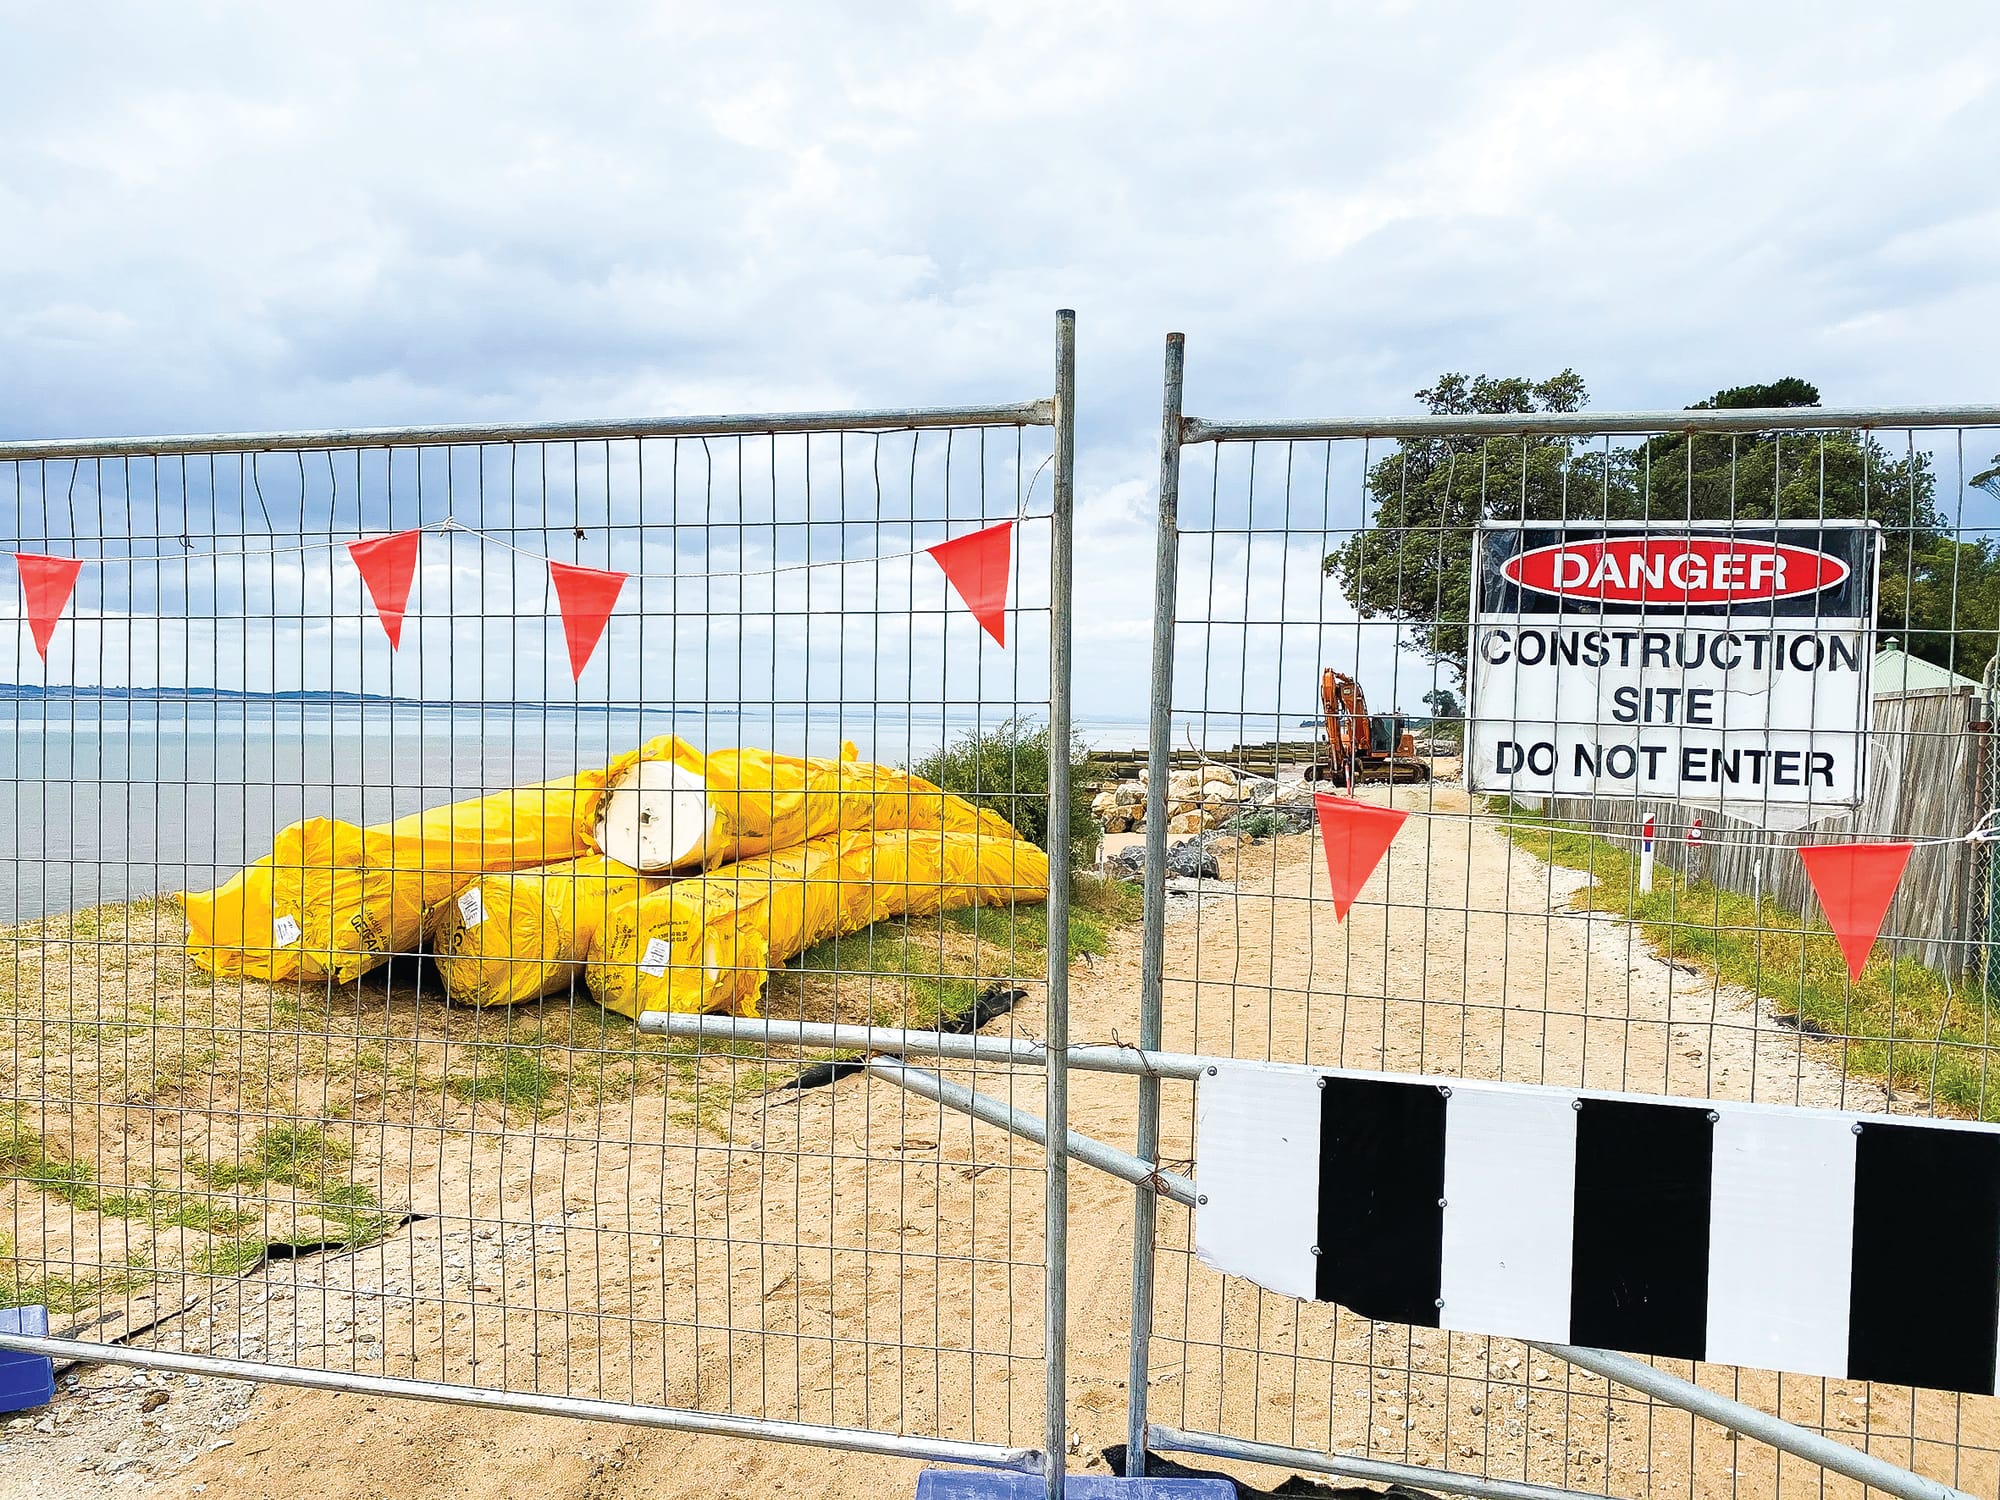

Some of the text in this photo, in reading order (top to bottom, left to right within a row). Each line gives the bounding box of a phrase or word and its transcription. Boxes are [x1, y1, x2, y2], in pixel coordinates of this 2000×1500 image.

[1553, 553, 1787, 590] DANGER
[1481, 630, 1860, 672] CONSTRUCTION
[1611, 686, 1714, 725] SITE
[1496, 740, 1834, 787] DO NOT ENTER
